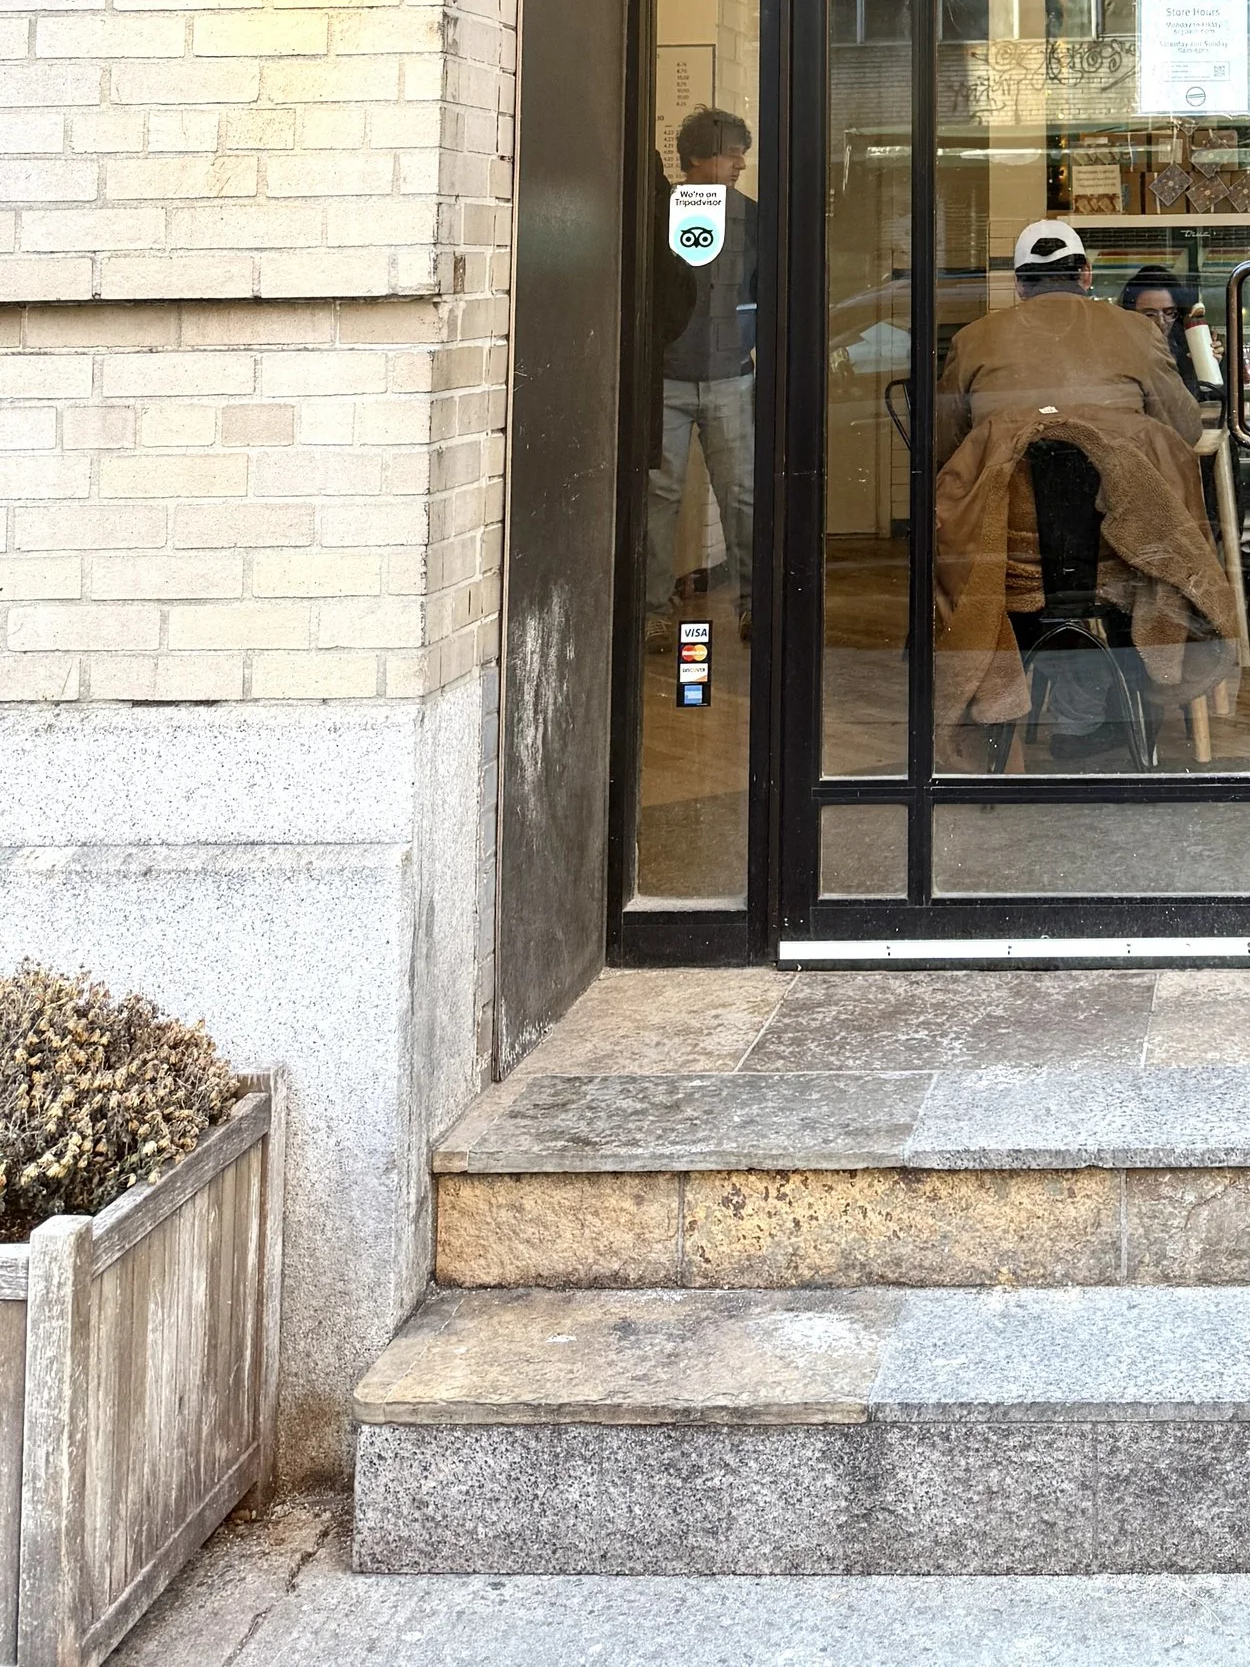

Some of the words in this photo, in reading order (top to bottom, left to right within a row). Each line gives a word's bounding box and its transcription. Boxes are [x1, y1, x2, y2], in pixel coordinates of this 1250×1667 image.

[1166, 7, 1191, 17] Store
[1193, 7, 1221, 17] Hours
[675, 199, 722, 207] Tripadvisor
[685, 629, 707, 637] VISA
